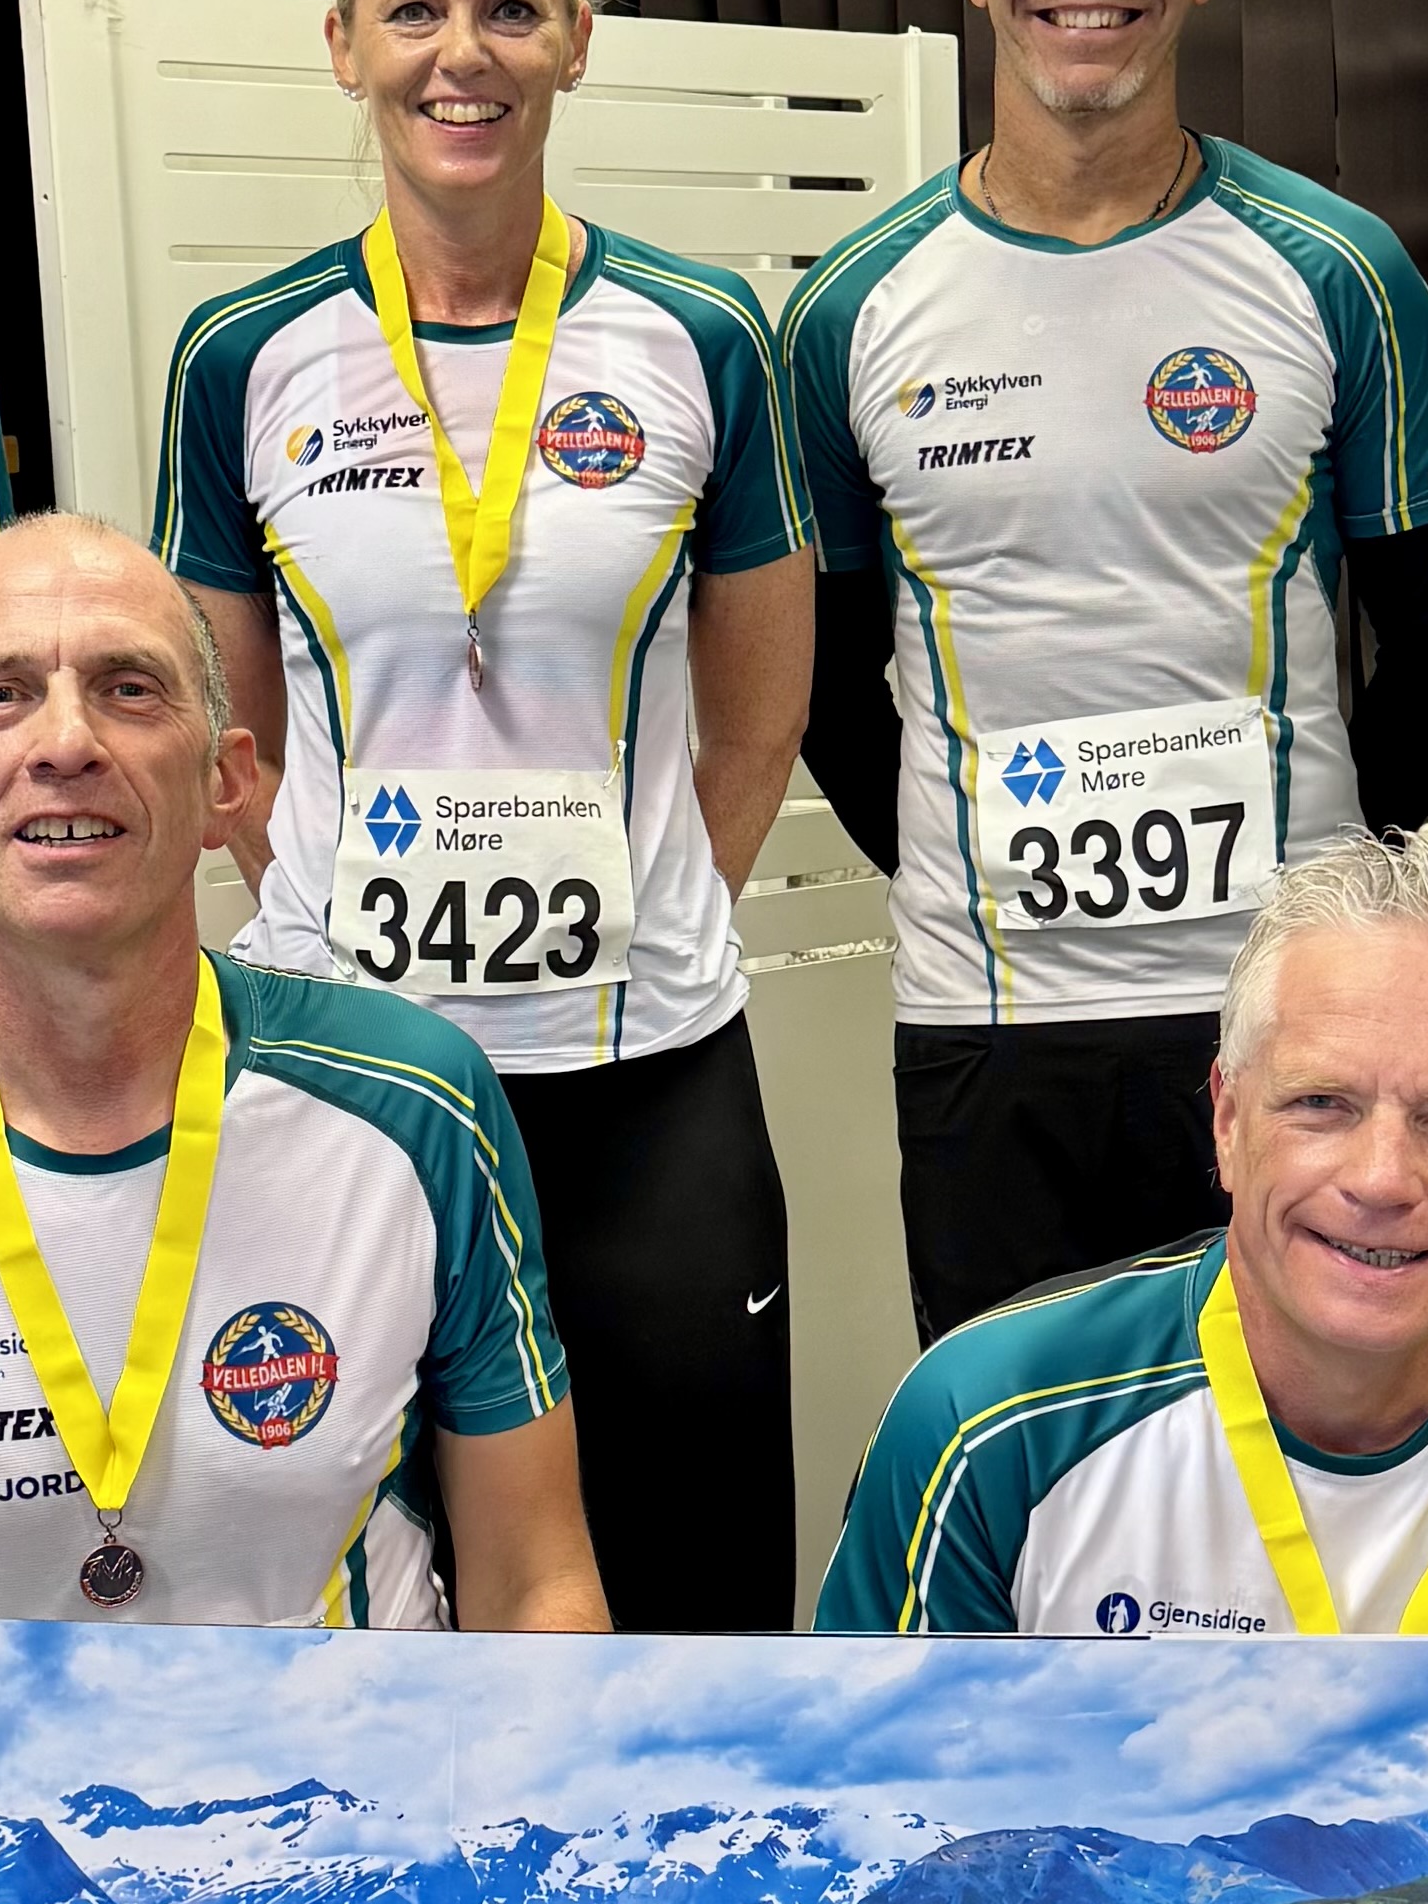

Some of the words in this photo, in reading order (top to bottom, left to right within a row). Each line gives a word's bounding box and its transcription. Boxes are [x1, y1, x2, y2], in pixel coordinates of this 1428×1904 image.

[945, 373, 1042, 398] Sykkylven
[1154, 388, 1230, 407] VELLEDALEN
[946, 394, 988, 410] Energi
[334, 434, 377, 451] Energi
[918, 435, 1036, 471] TRIMTEX
[1192, 435, 1216, 447] 1906
[1078, 726, 1242, 764] Sparebanken
[1081, 766, 1146, 793] Møre
[435, 795, 602, 823] Sparebanken
[436, 828, 502, 852] Møre
[1008, 801, 1245, 921] 3397
[355, 877, 600, 984] 3423
[213, 1357, 307, 1389] VELLEDALEN
[261, 1423, 291, 1440] 1906
[1149, 1601, 1266, 1633] Gjensidige
